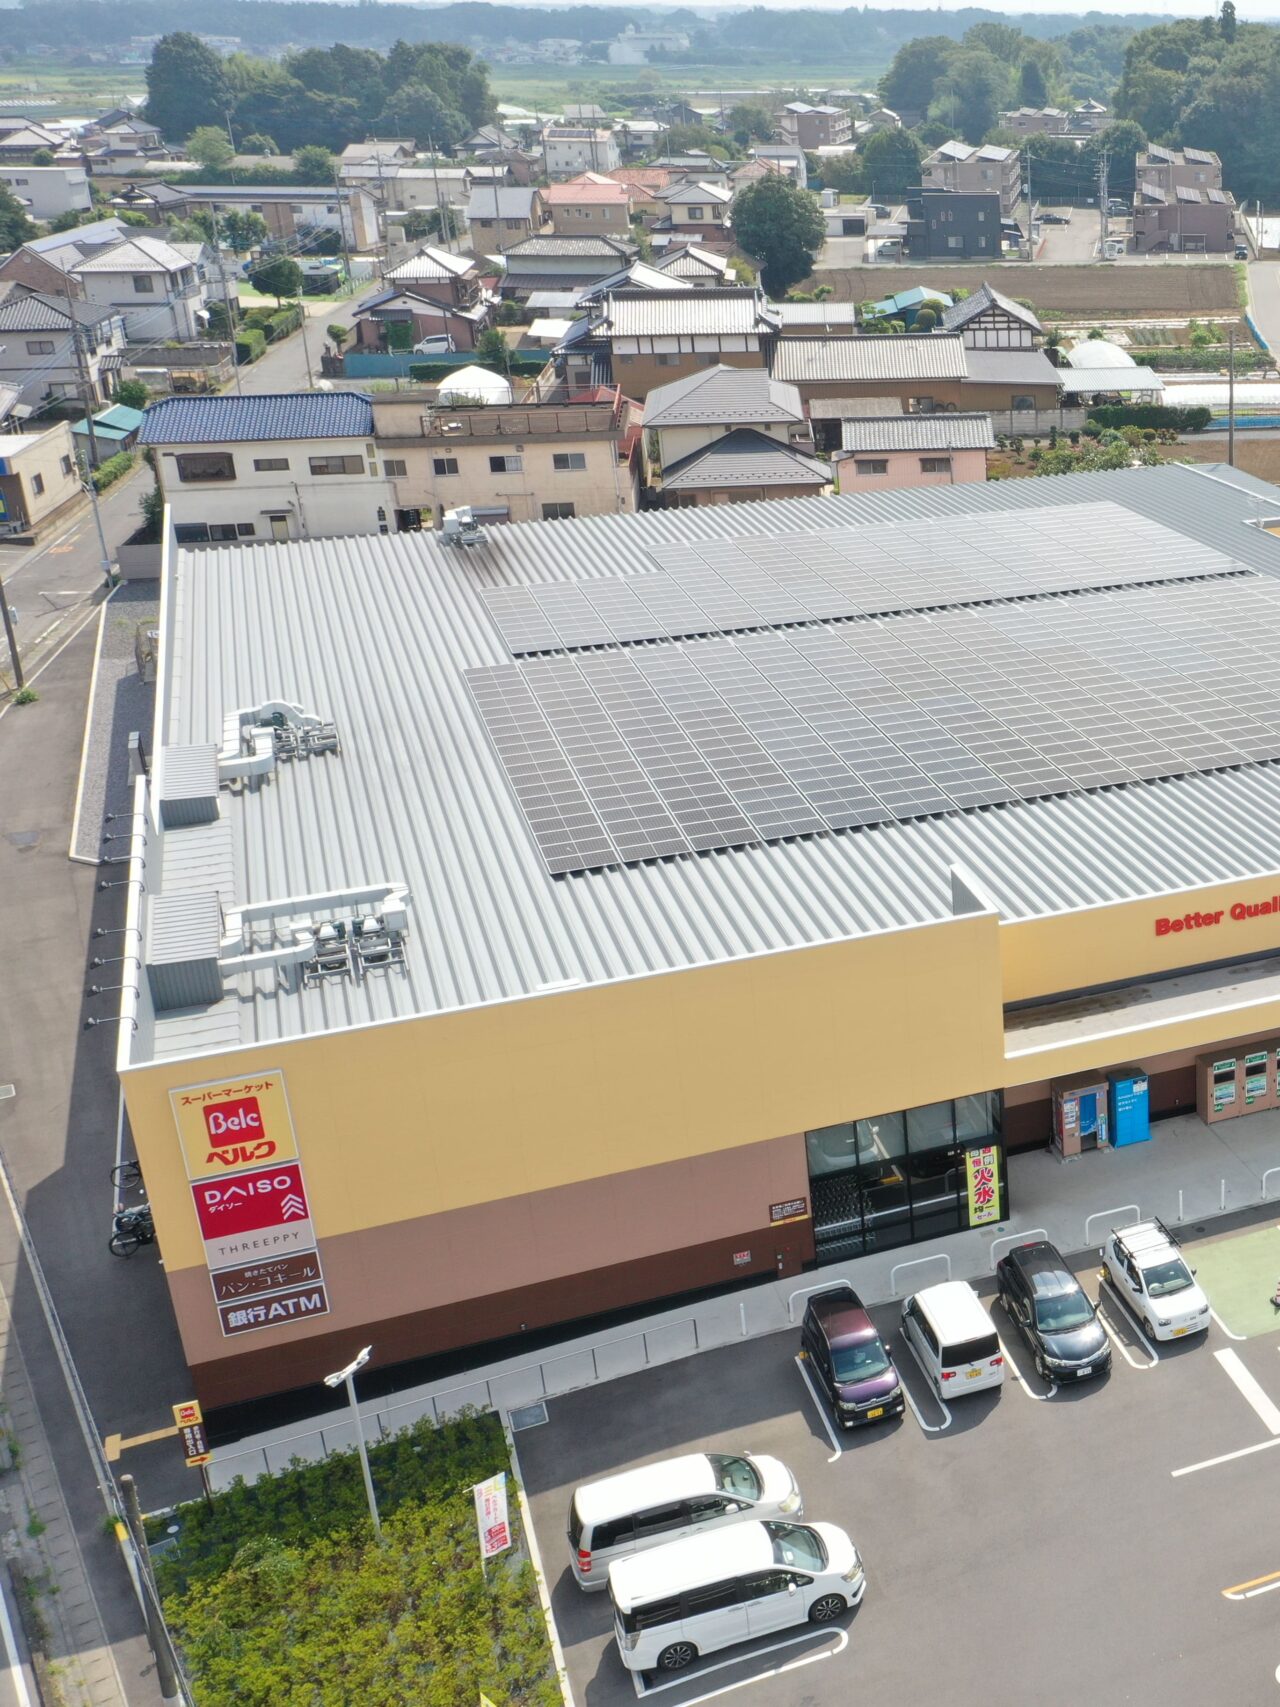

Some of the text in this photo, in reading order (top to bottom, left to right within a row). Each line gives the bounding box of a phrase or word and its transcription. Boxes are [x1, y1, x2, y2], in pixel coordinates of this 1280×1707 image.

[1155, 909, 1225, 936] Better
[181, 1081, 273, 1106] スーパーマーケット
[208, 1107, 260, 1135] Belc
[206, 1140, 276, 1166] ベルク
[204, 1175, 292, 1205] DAISO
[208, 1202, 243, 1214] ダイソー
[218, 1232, 299, 1256] THREEPPY
[227, 1293, 322, 1328] 銀行ATM
